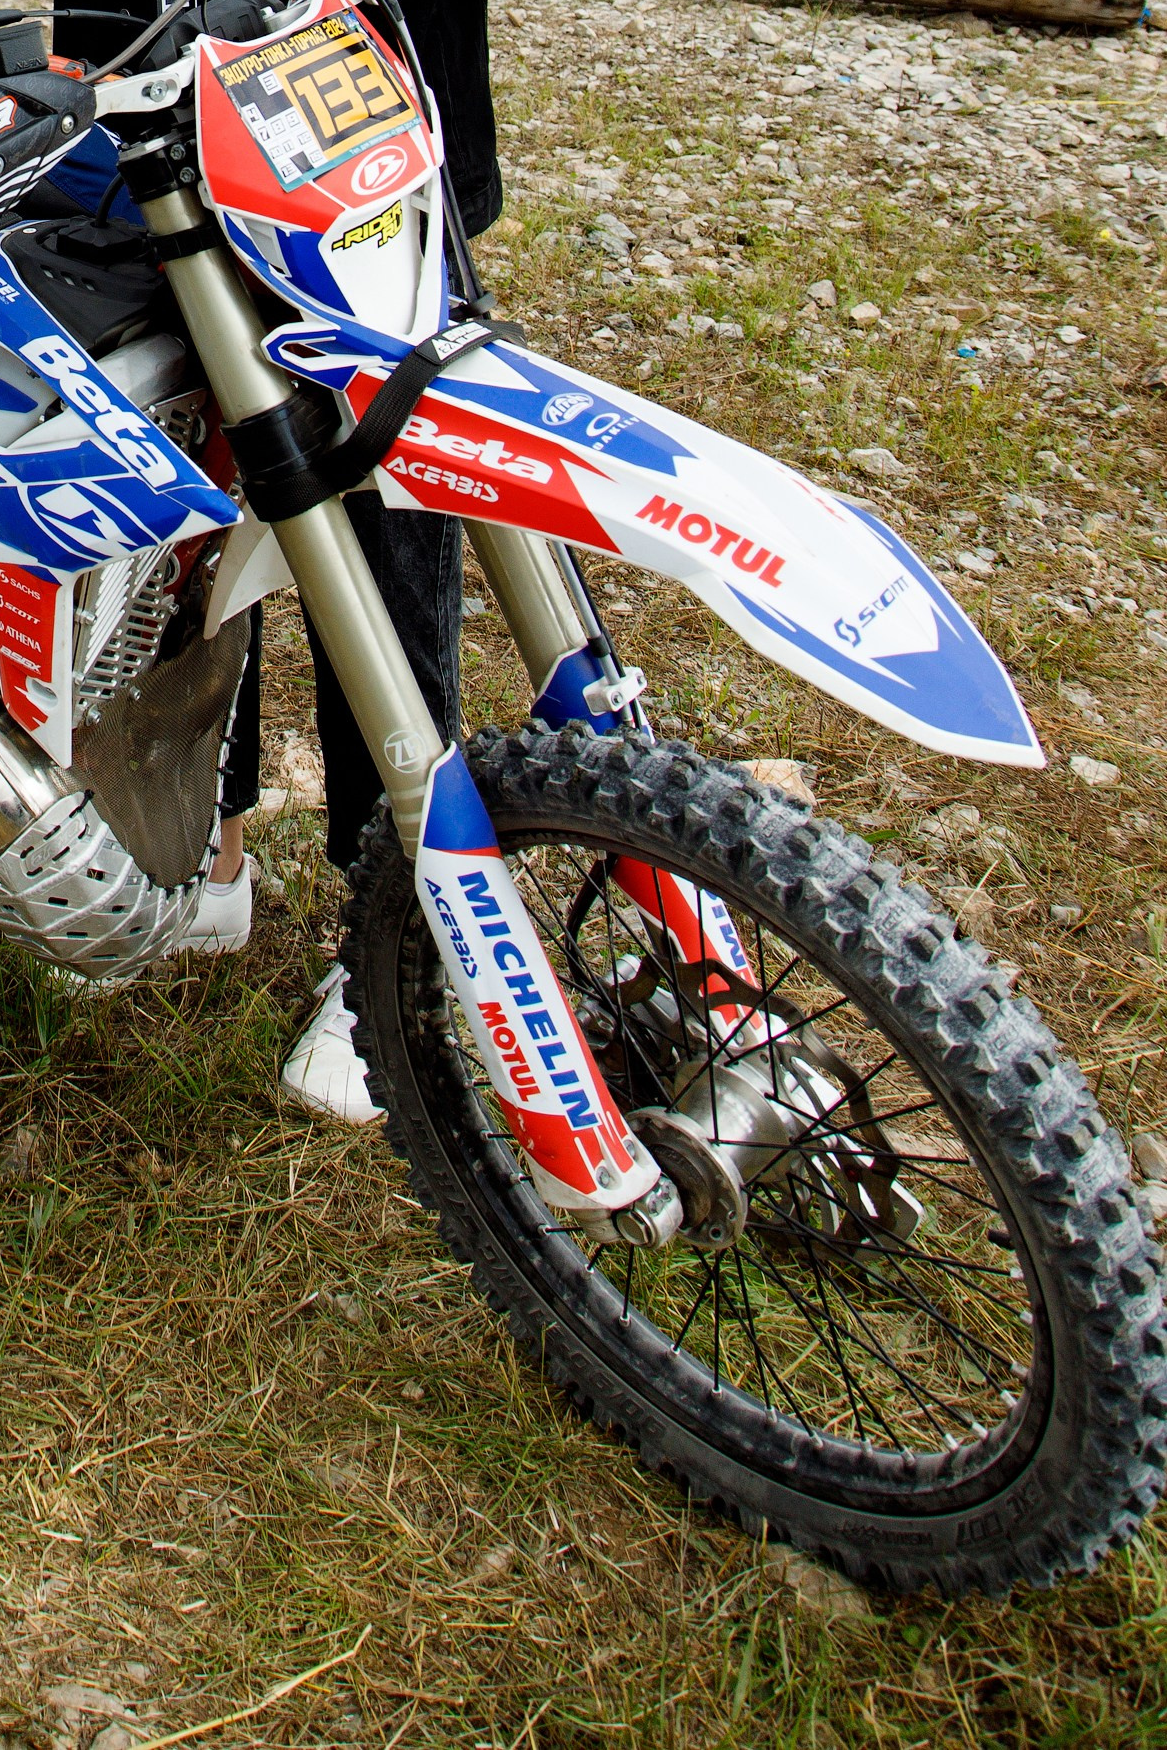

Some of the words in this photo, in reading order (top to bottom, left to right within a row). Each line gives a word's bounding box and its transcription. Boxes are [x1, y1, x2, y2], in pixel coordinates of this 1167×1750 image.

[323, 17, 348, 41] 2024
[292, 48, 402, 139] 133
[19, 334, 178, 489] Beta
[592, 415, 641, 452] OAKLEY
[385, 456, 499, 502] ACERBIS
[397, 415, 554, 485] Beta
[634, 494, 787, 589] MOTUL
[4, 602, 41, 625] SCOTT
[9, 578, 41, 601] SACHS
[858, 575, 911, 629] SCOTT
[5, 625, 42, 653] ATHENA
[423, 876, 481, 980] ACERBIS
[457, 870, 600, 1132] MICHELIN
[477, 1001, 542, 1103] MOTUL
